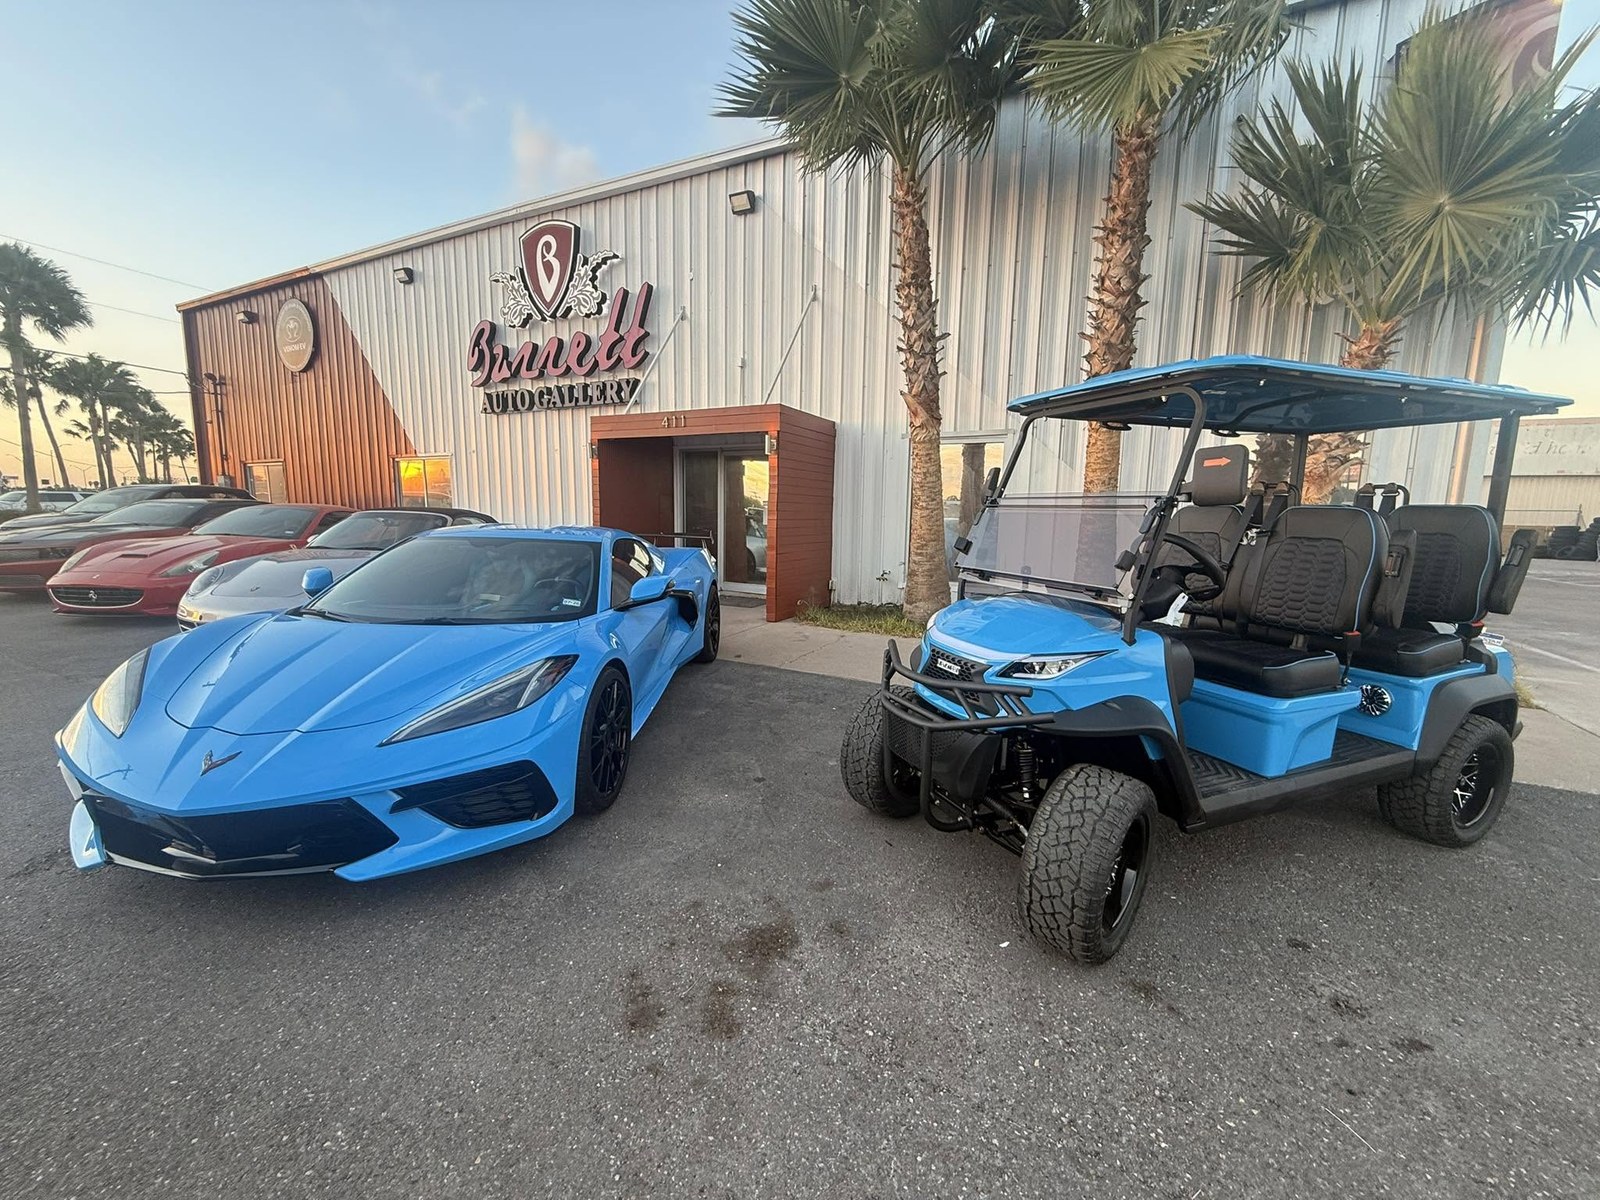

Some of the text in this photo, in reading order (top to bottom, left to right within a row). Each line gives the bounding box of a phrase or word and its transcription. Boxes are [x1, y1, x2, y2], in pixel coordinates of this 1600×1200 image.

[481, 378, 639, 414] AUTO GALLERY
[661, 415, 686, 428] 411
